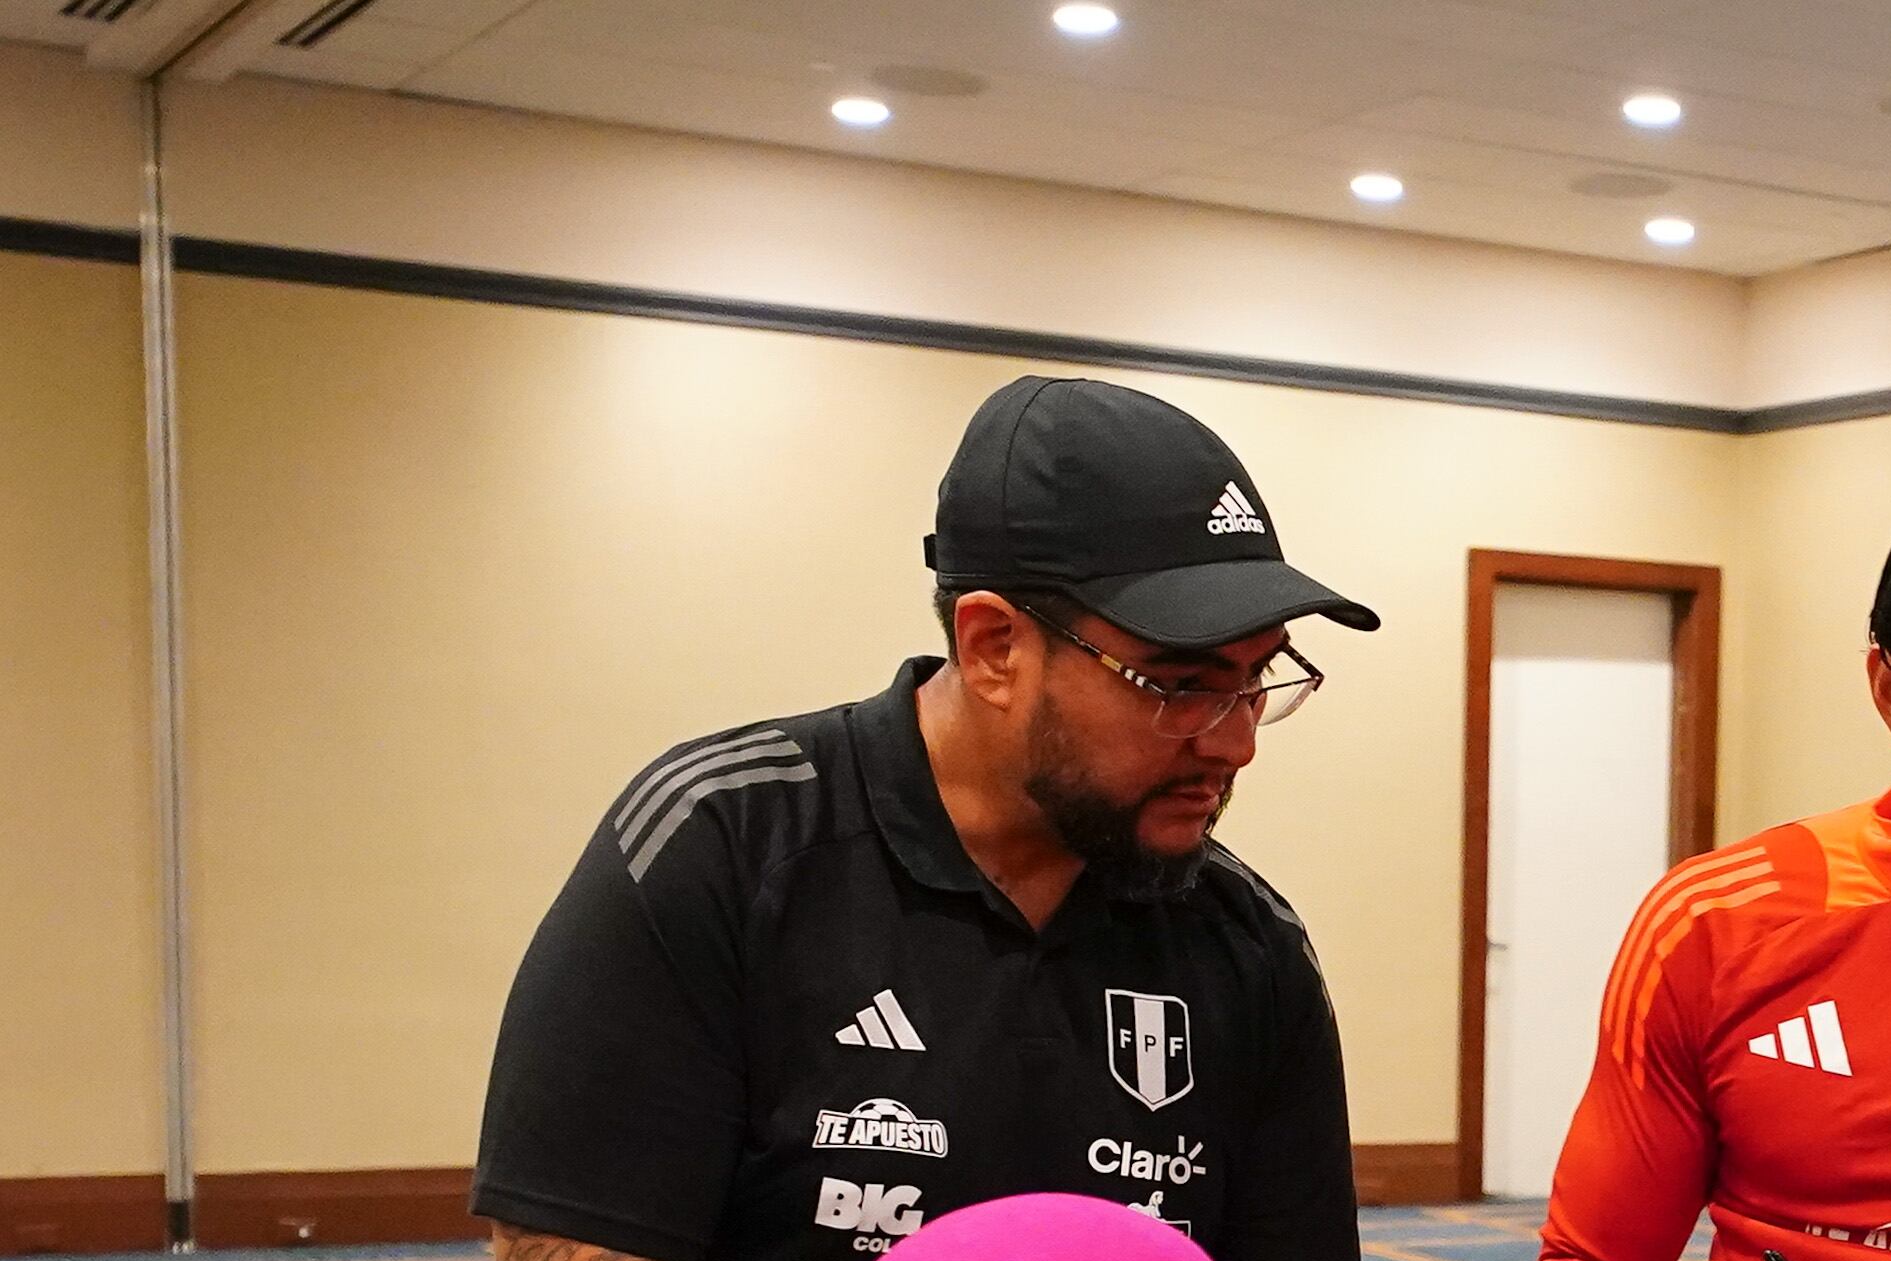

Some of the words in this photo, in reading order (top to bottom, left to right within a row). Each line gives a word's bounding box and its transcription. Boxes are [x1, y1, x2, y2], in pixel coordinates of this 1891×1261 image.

[1207, 513, 1266, 535] adidas
[818, 1113, 849, 1145] TE
[847, 1118, 944, 1155] APUESTO
[1087, 1137, 1192, 1185] Claro
[814, 1176, 925, 1237] BIG
[852, 1236, 892, 1254] COL
